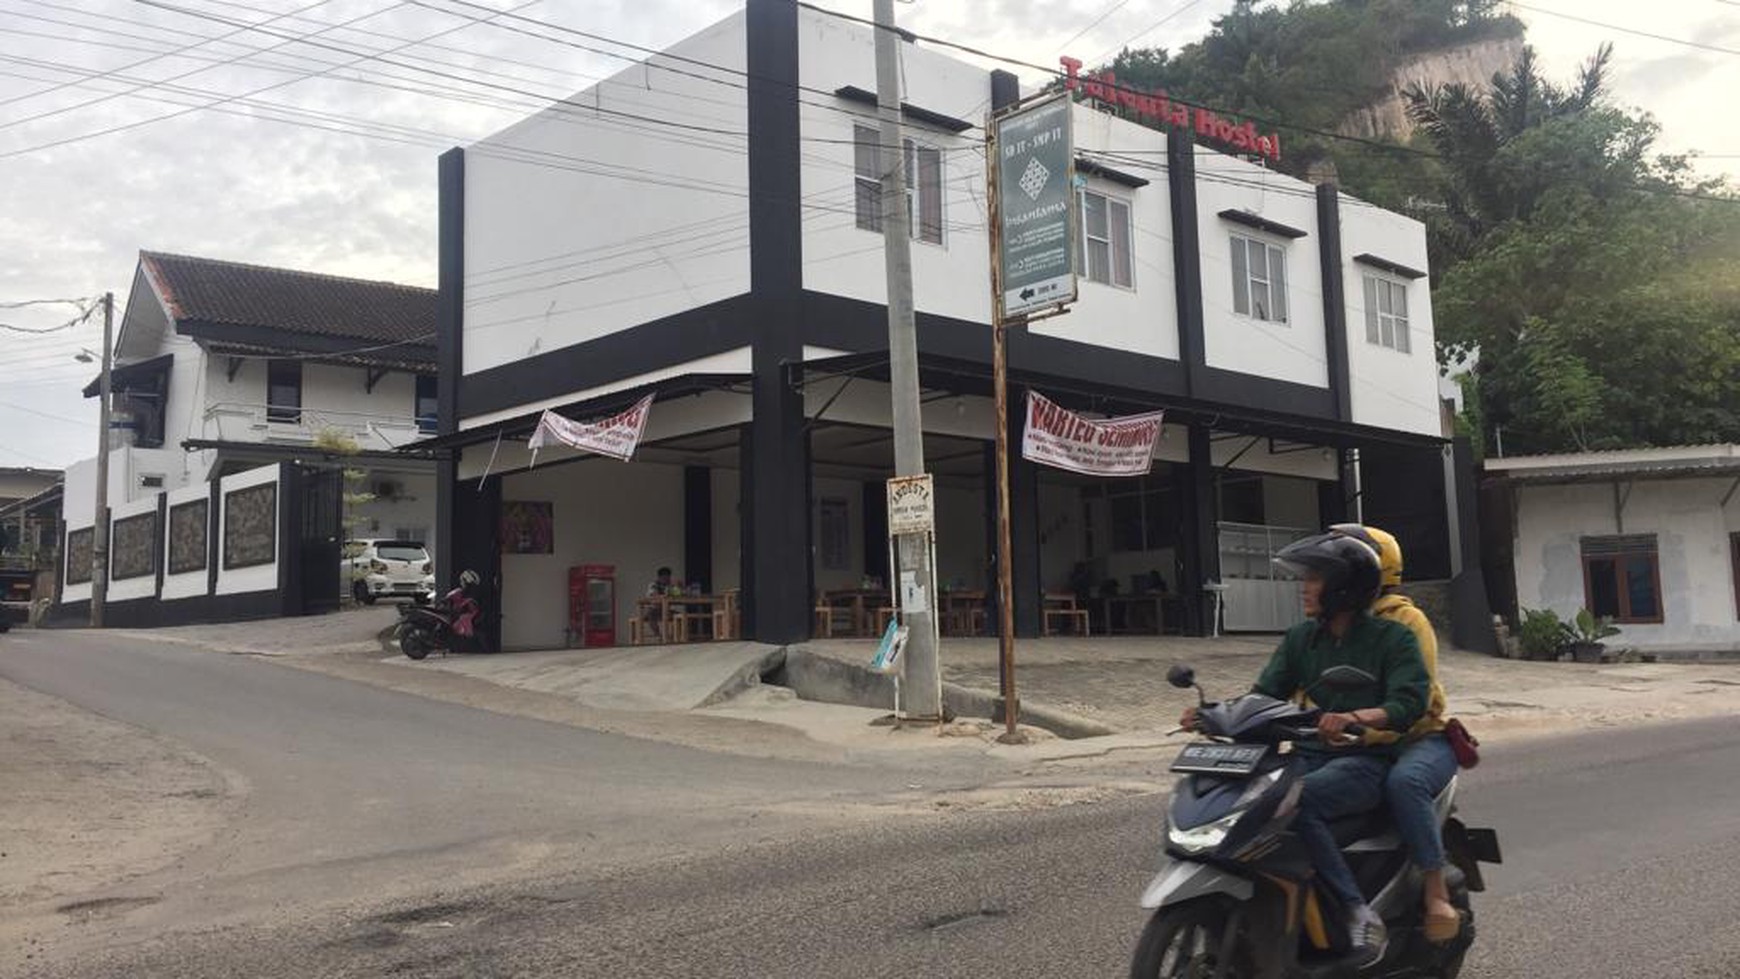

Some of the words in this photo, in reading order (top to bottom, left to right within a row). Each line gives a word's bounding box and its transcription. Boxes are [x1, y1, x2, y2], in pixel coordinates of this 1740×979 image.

[1017, 140, 1026, 154] IT
[1033, 131, 1051, 149] SMP
[1052, 127, 1062, 142] IT
[1195, 108, 1280, 161] Hostel
